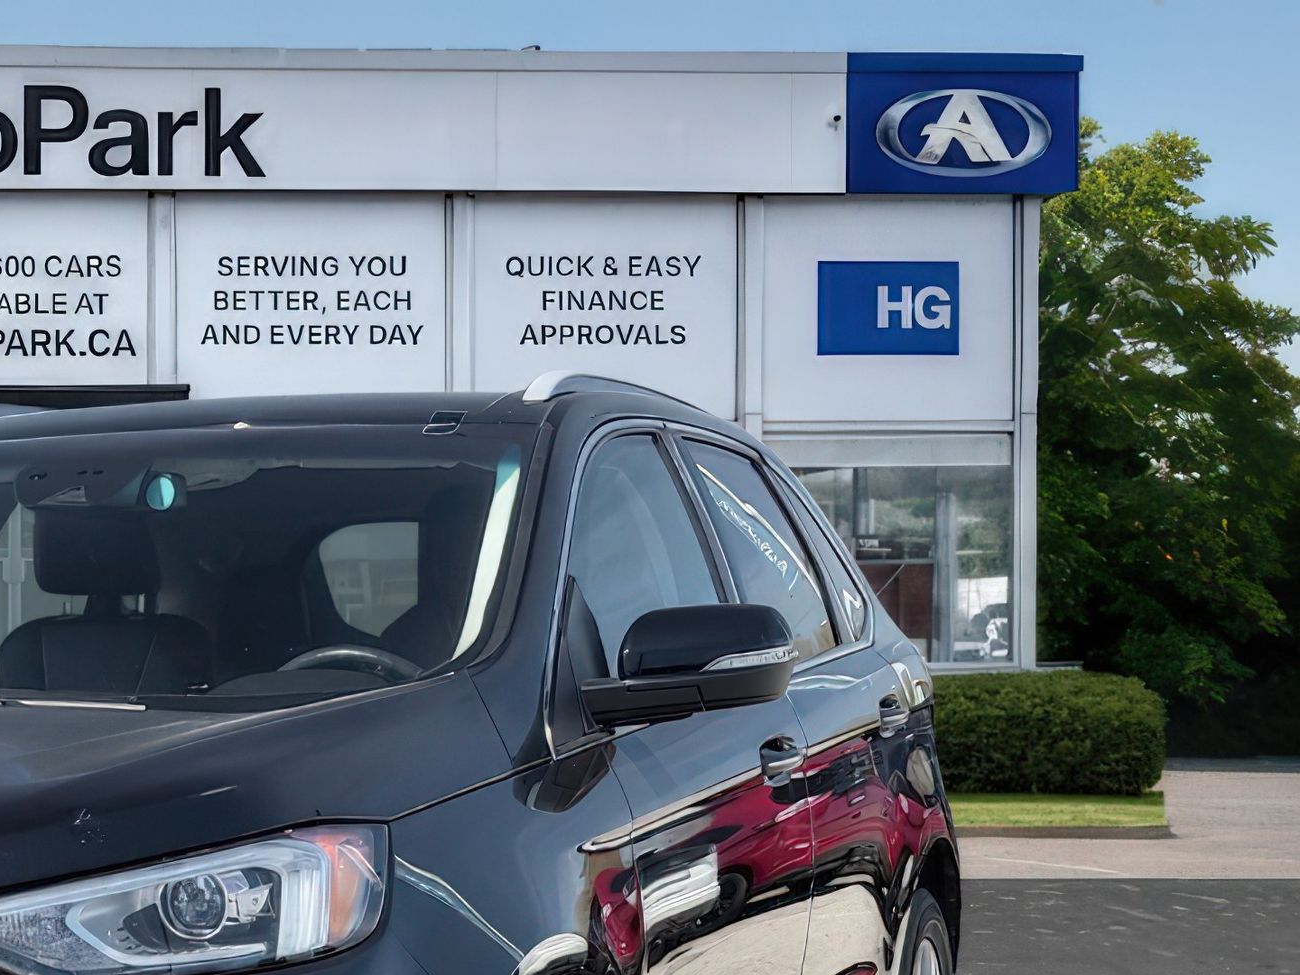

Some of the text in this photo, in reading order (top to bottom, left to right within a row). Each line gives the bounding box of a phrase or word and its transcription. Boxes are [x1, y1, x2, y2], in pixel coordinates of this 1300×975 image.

[44, 254, 122, 278] CARS
[217, 255, 407, 277] SERVING YOU
[505, 255, 702, 278] QUICK & EASY
[74, 292, 109, 315] AT
[213, 290, 412, 315] BETTER, EACH
[542, 290, 665, 311] FINANCE
[877, 285, 952, 330] HG
[200, 324, 424, 346] AND EVERY DAY
[519, 323, 686, 346] APPROVALS
